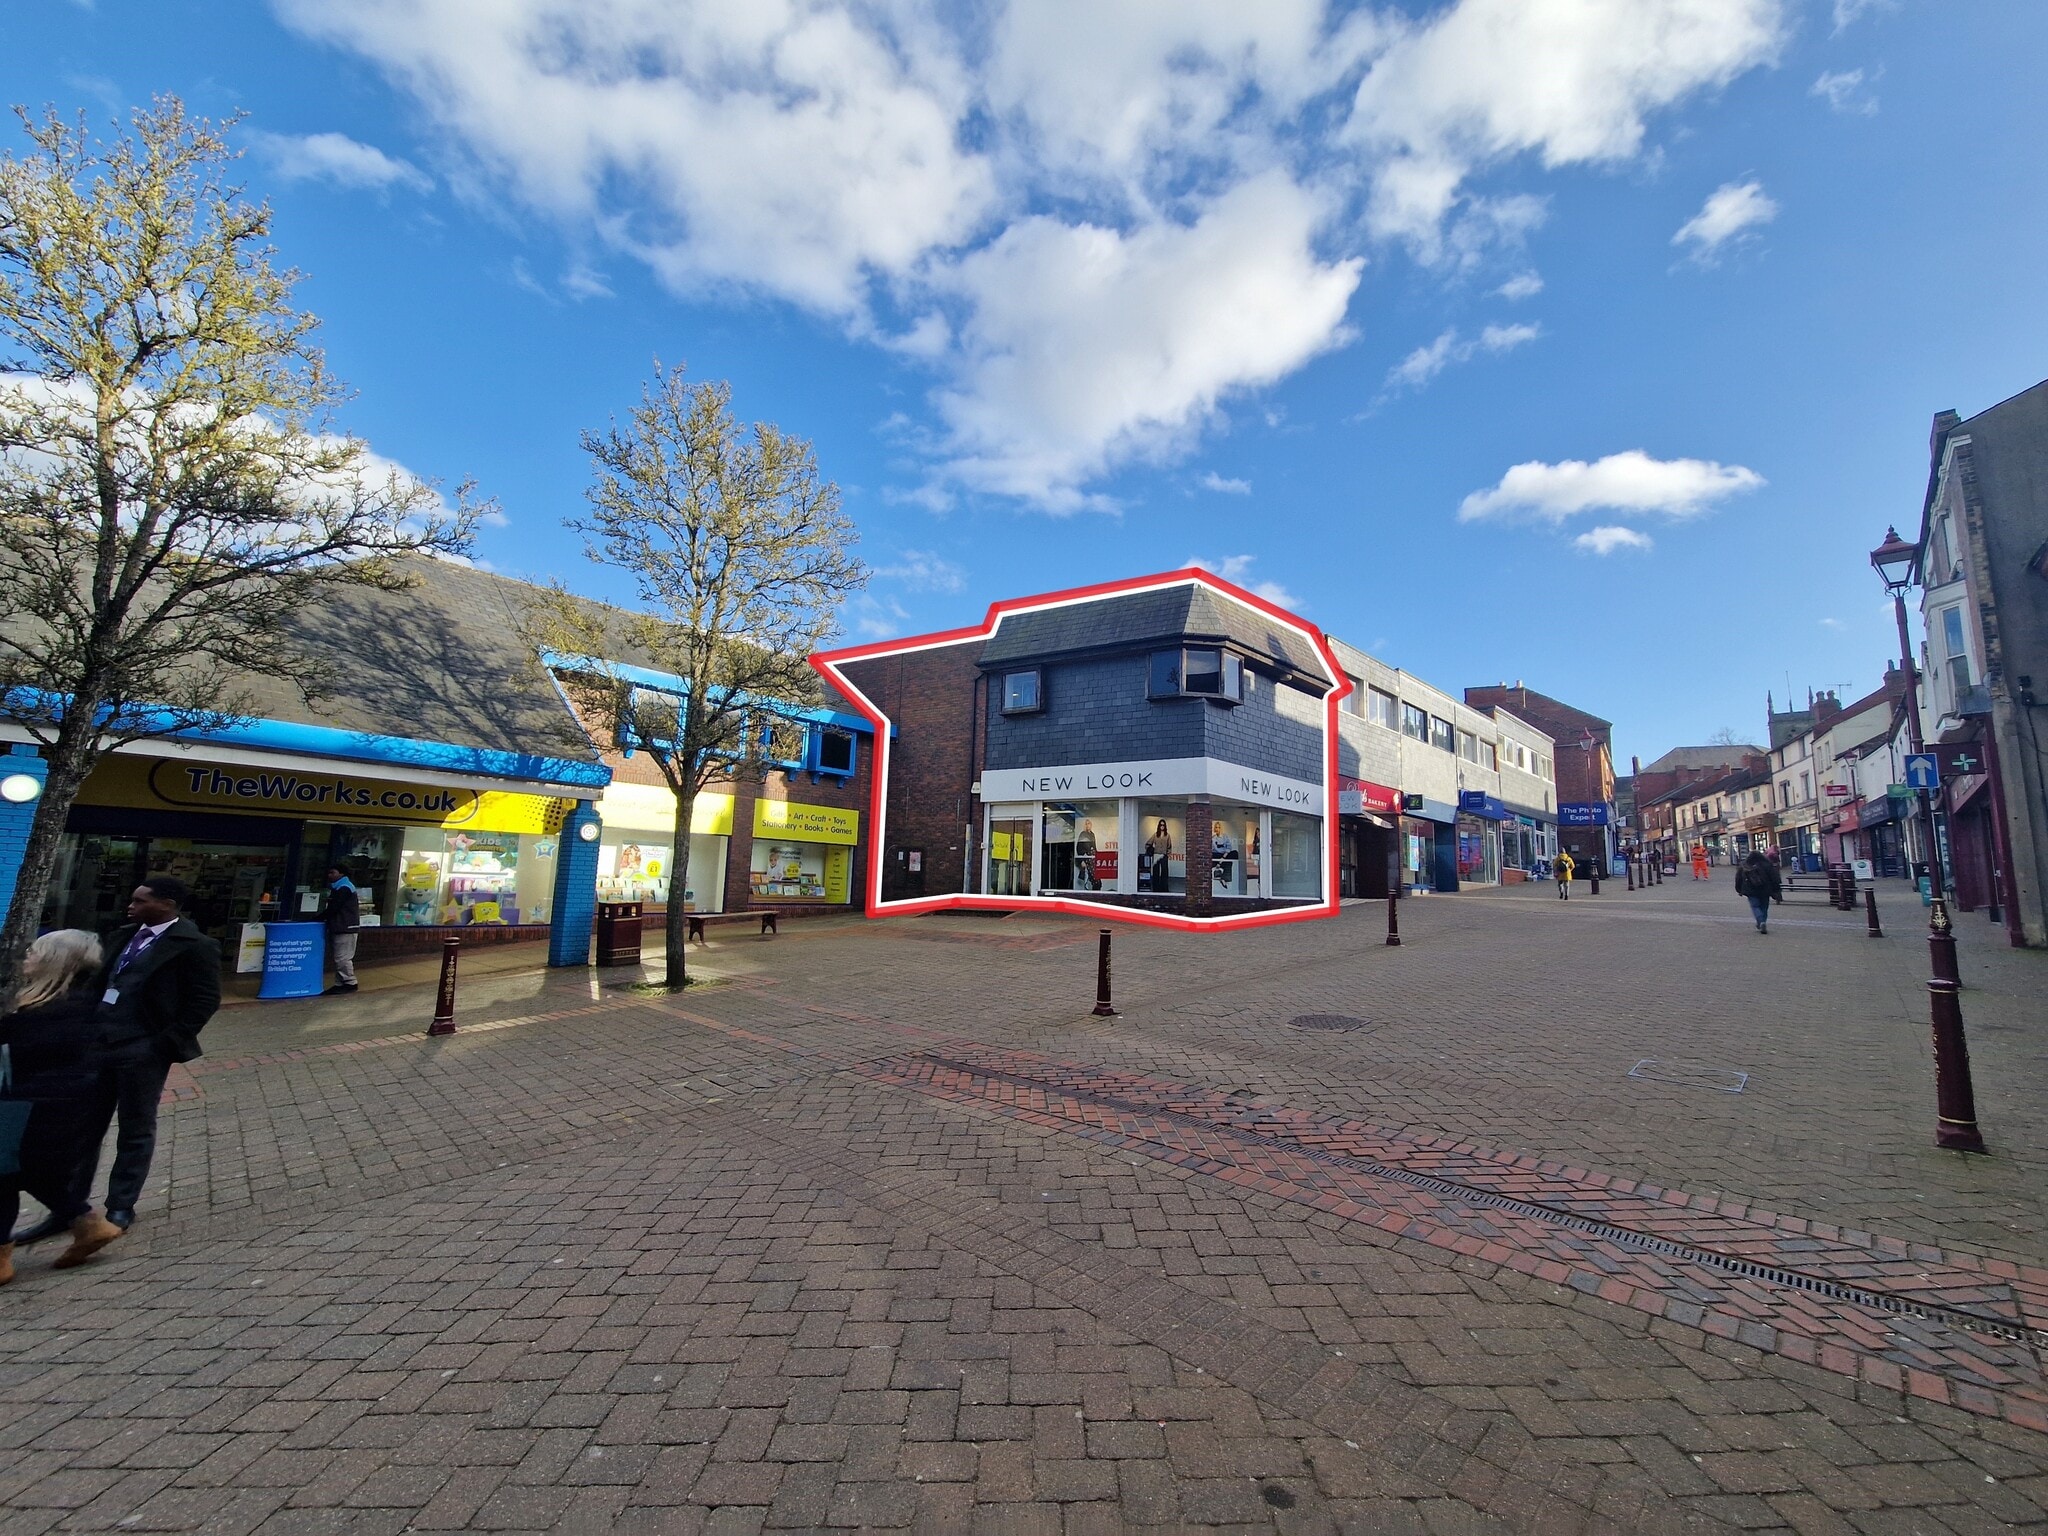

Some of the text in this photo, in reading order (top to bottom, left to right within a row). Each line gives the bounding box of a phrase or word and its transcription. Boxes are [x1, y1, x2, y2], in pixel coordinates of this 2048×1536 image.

[185, 767, 456, 812] TheWorks.co.uk
[1023, 772, 1152, 792] NEW LOOK
[1242, 778, 1309, 804] NEW LOOK
[1368, 798, 1387, 807] BAKERY
[762, 820, 852, 834] Stationery Books Games
[810, 814, 826, 822] Craft
[833, 816, 846, 825] Toys
